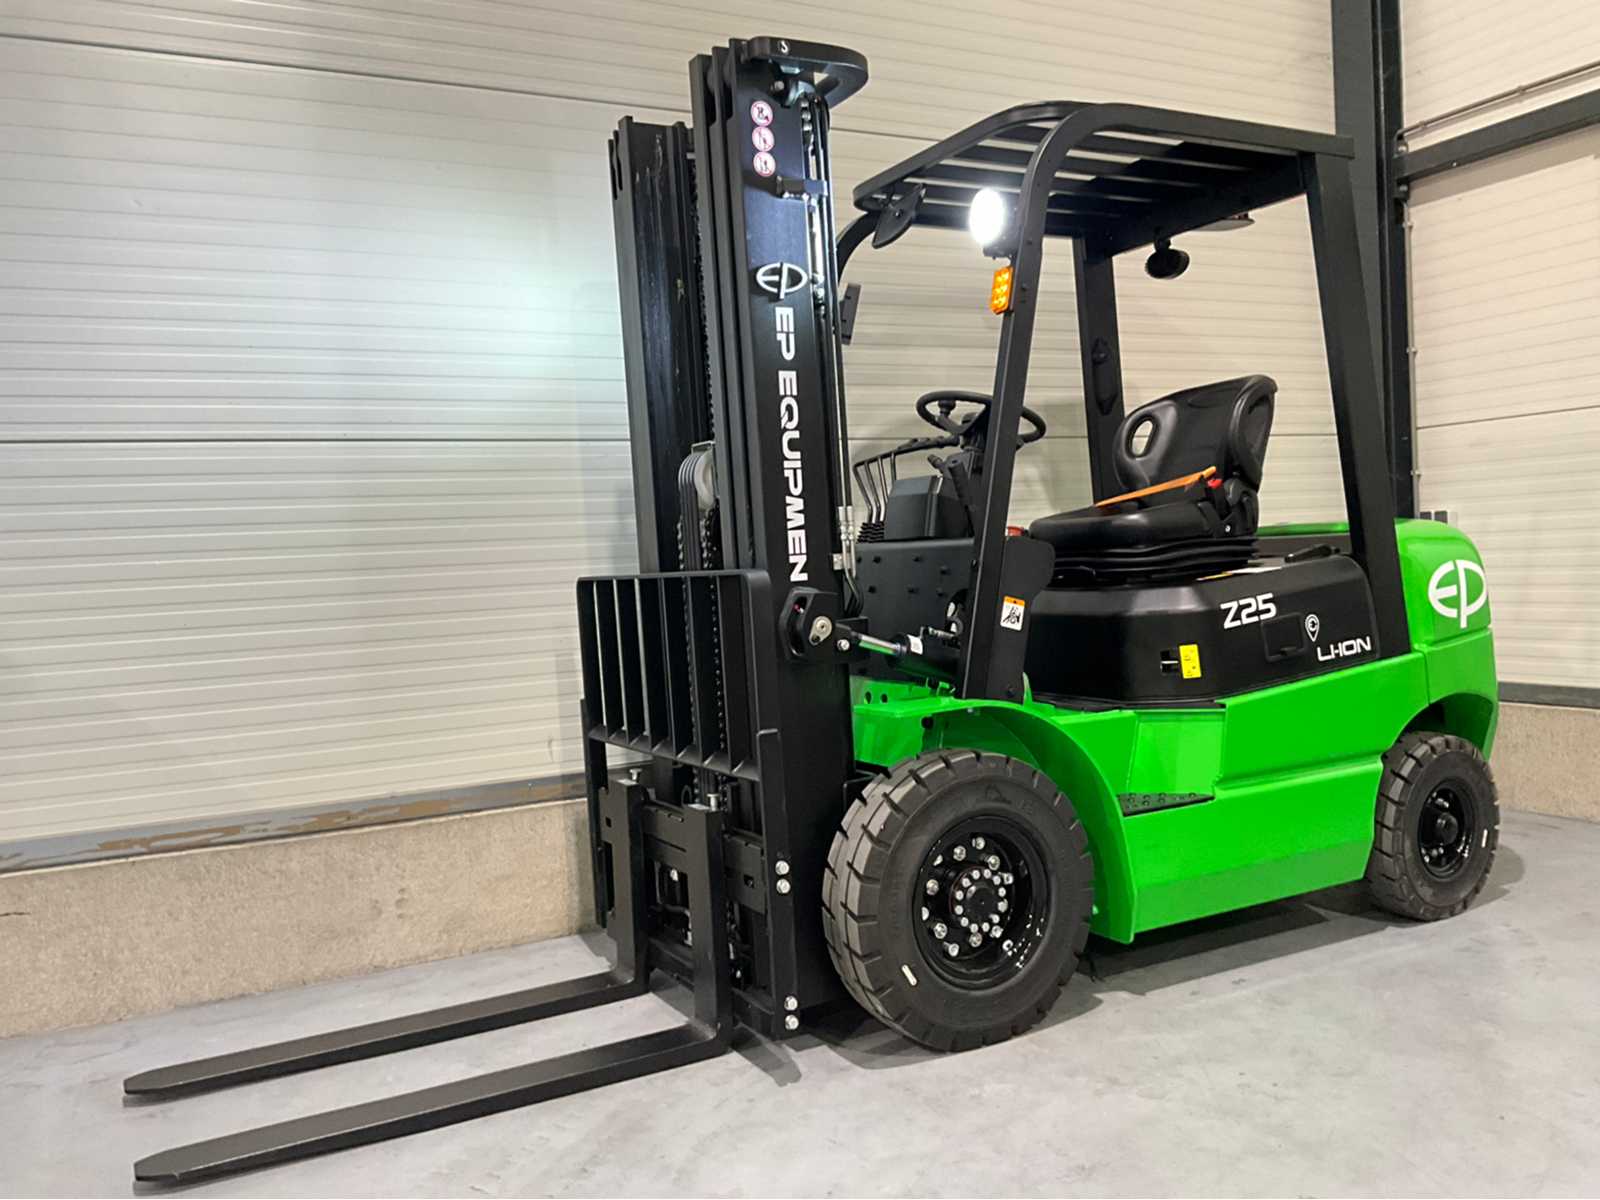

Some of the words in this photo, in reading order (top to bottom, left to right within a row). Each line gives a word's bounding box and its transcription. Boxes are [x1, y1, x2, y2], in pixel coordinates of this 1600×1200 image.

[756, 262, 808, 299] EP
[775, 306, 795, 360] EP
[1220, 592, 1276, 629] Z25
[1428, 559, 1487, 628] EP
